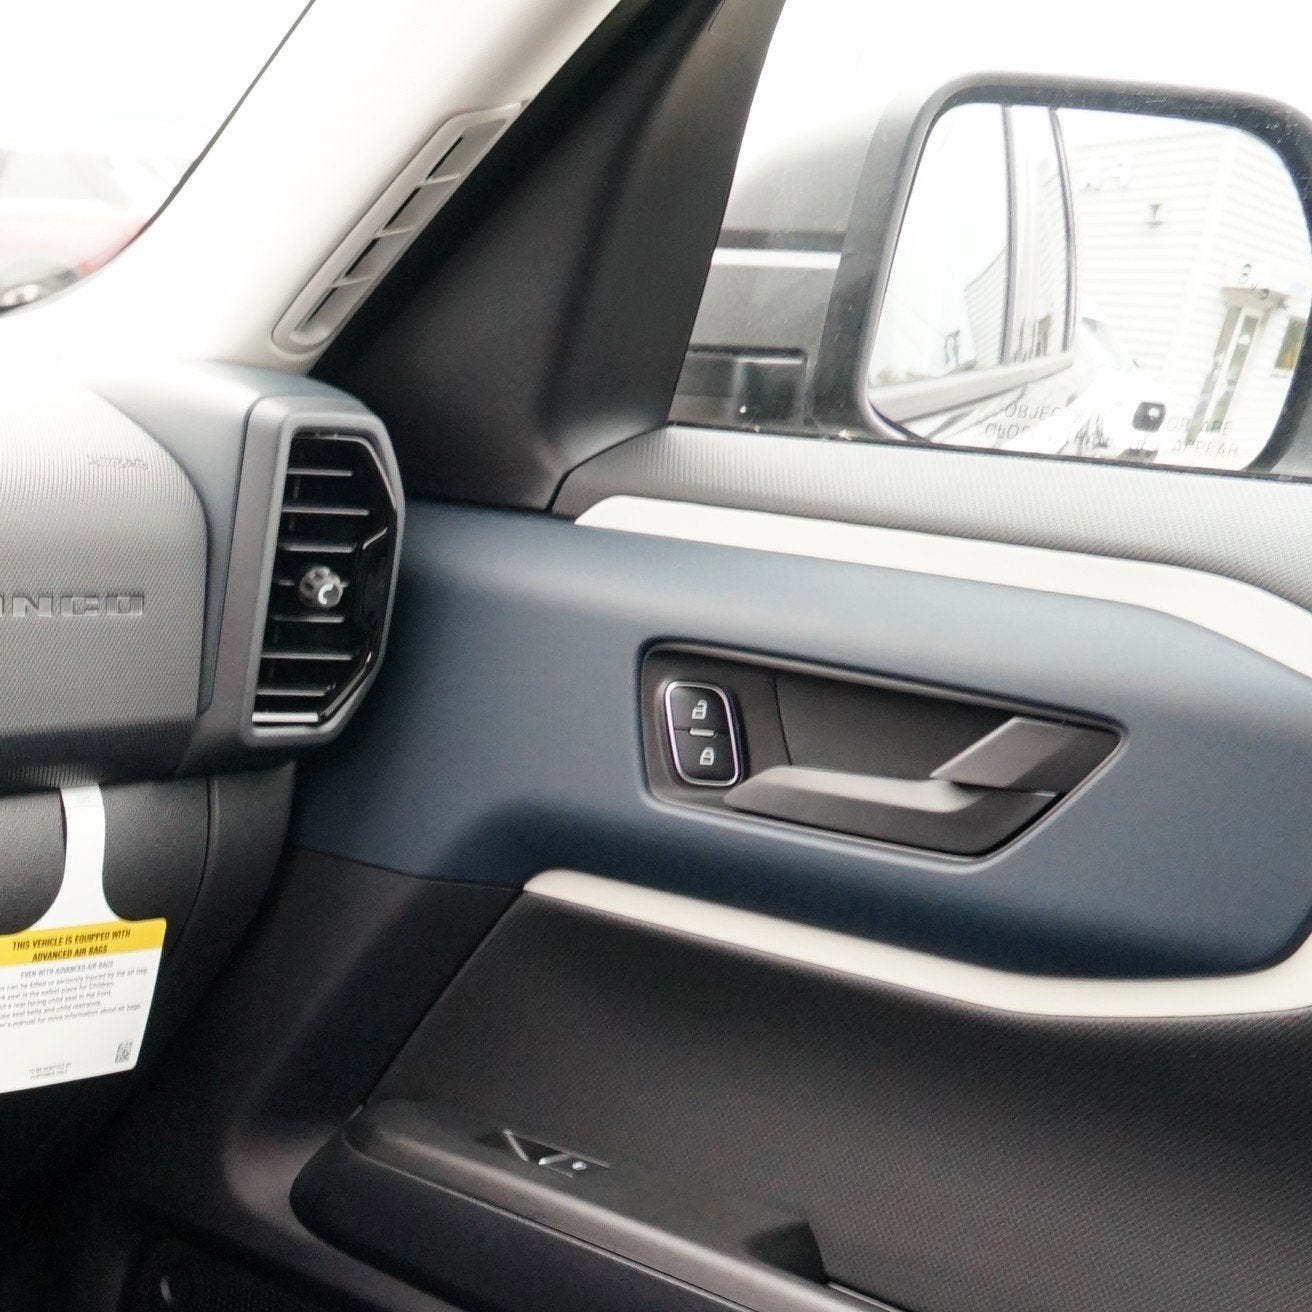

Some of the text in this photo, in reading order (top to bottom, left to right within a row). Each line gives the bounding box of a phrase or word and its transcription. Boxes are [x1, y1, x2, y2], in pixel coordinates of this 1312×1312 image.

[13, 929, 131, 951] THIS VEHICLE IS EQUIPPED WITH
[32, 945, 108, 963] ADVANCED AIR BAGS
